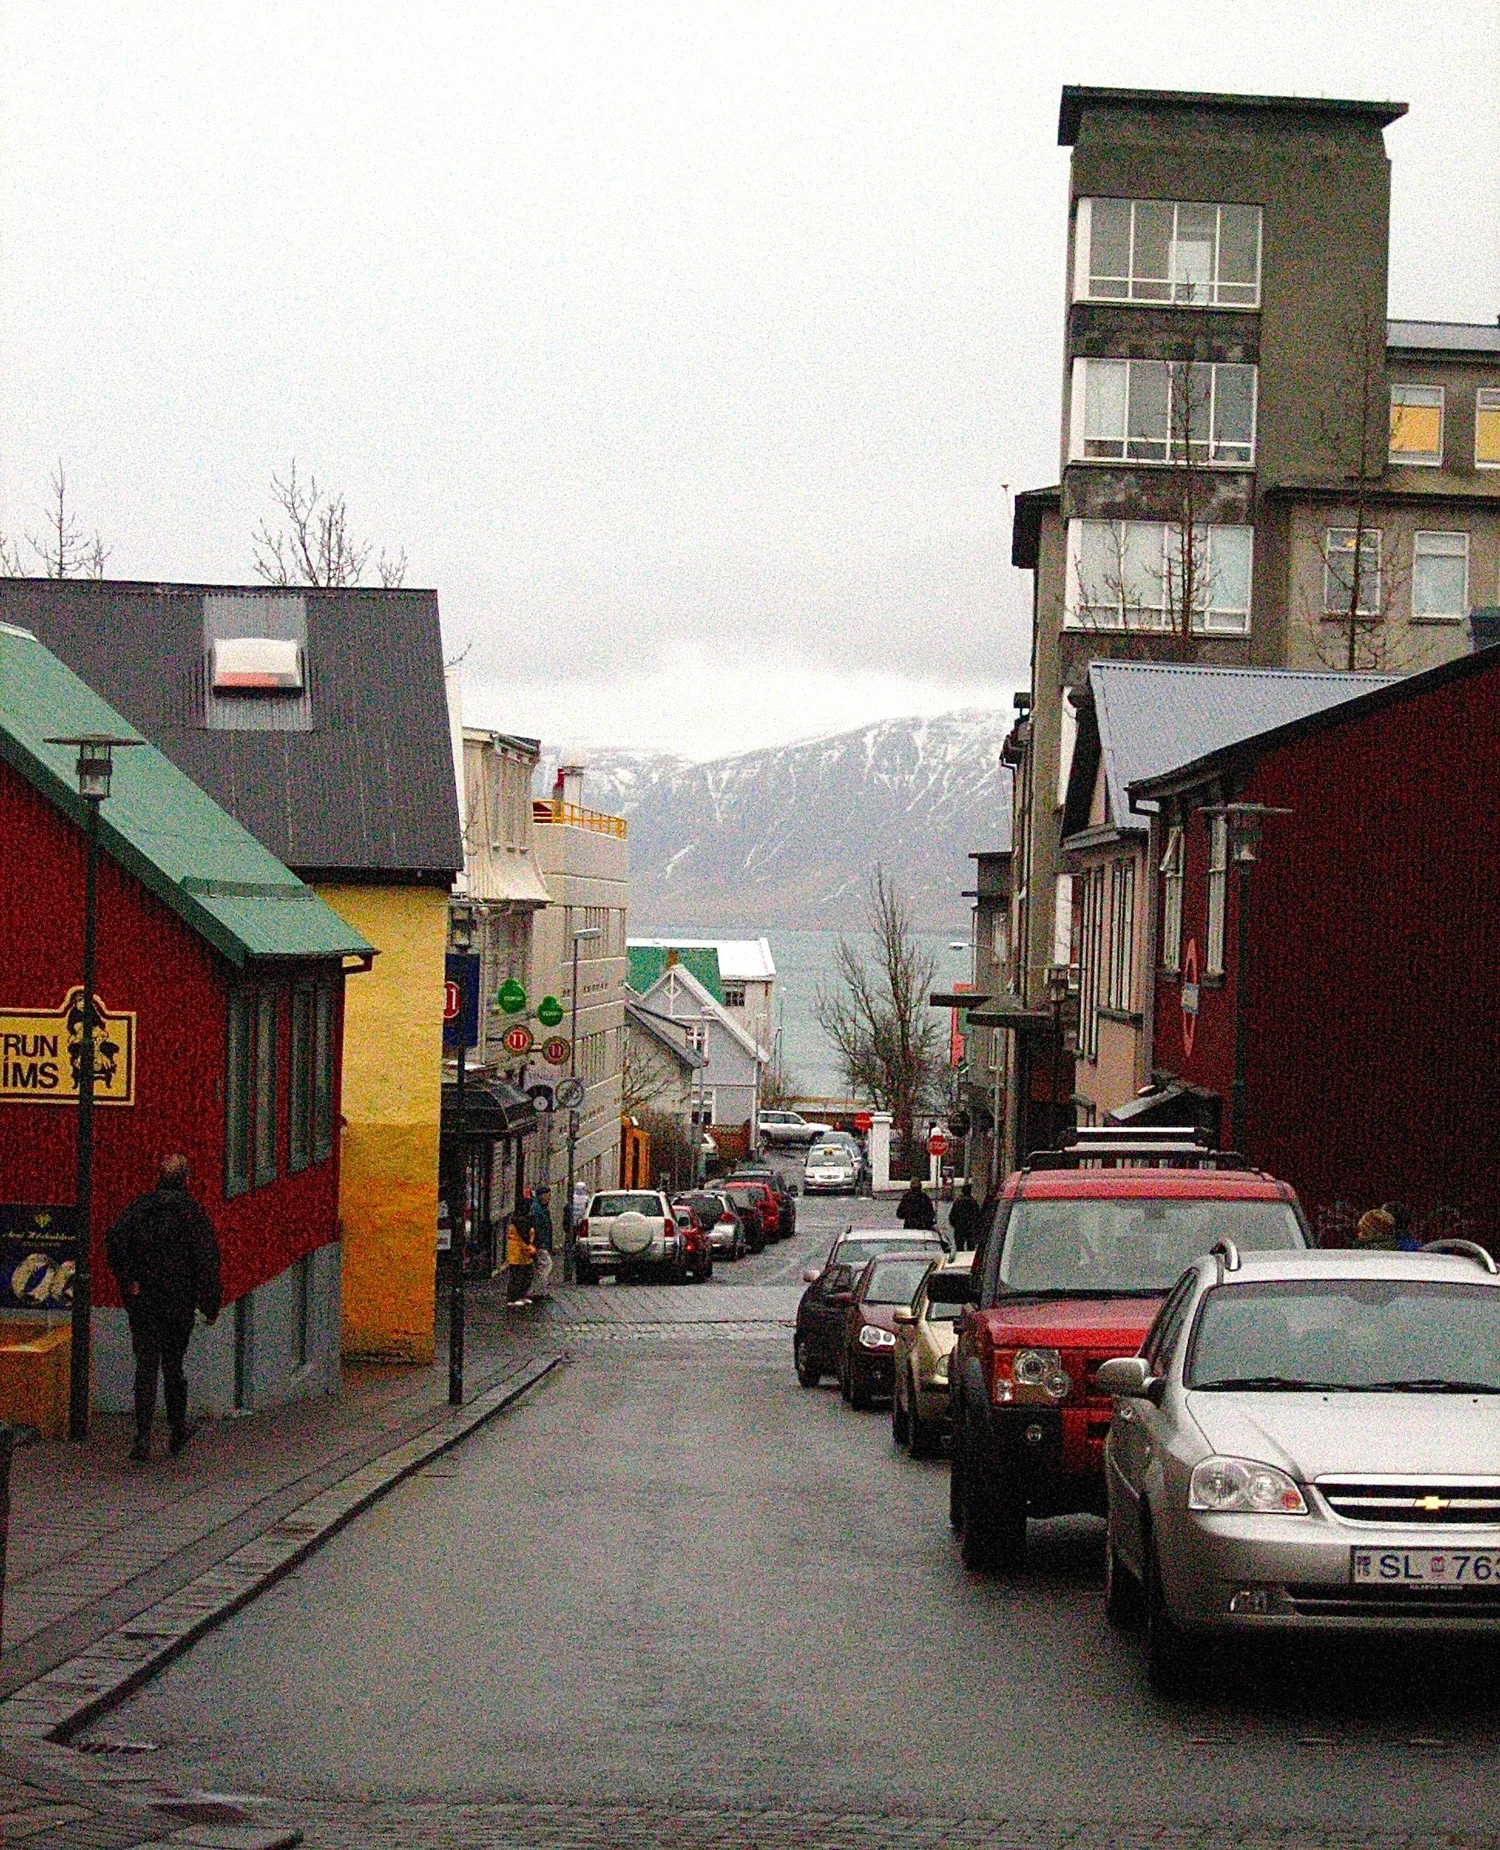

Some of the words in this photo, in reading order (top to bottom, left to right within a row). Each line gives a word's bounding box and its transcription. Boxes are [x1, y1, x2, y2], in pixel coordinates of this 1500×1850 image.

[0, 1033, 58, 1058] RUN
[929, 1141, 948, 1150] STOP
[1379, 1554, 1423, 1579] SL
